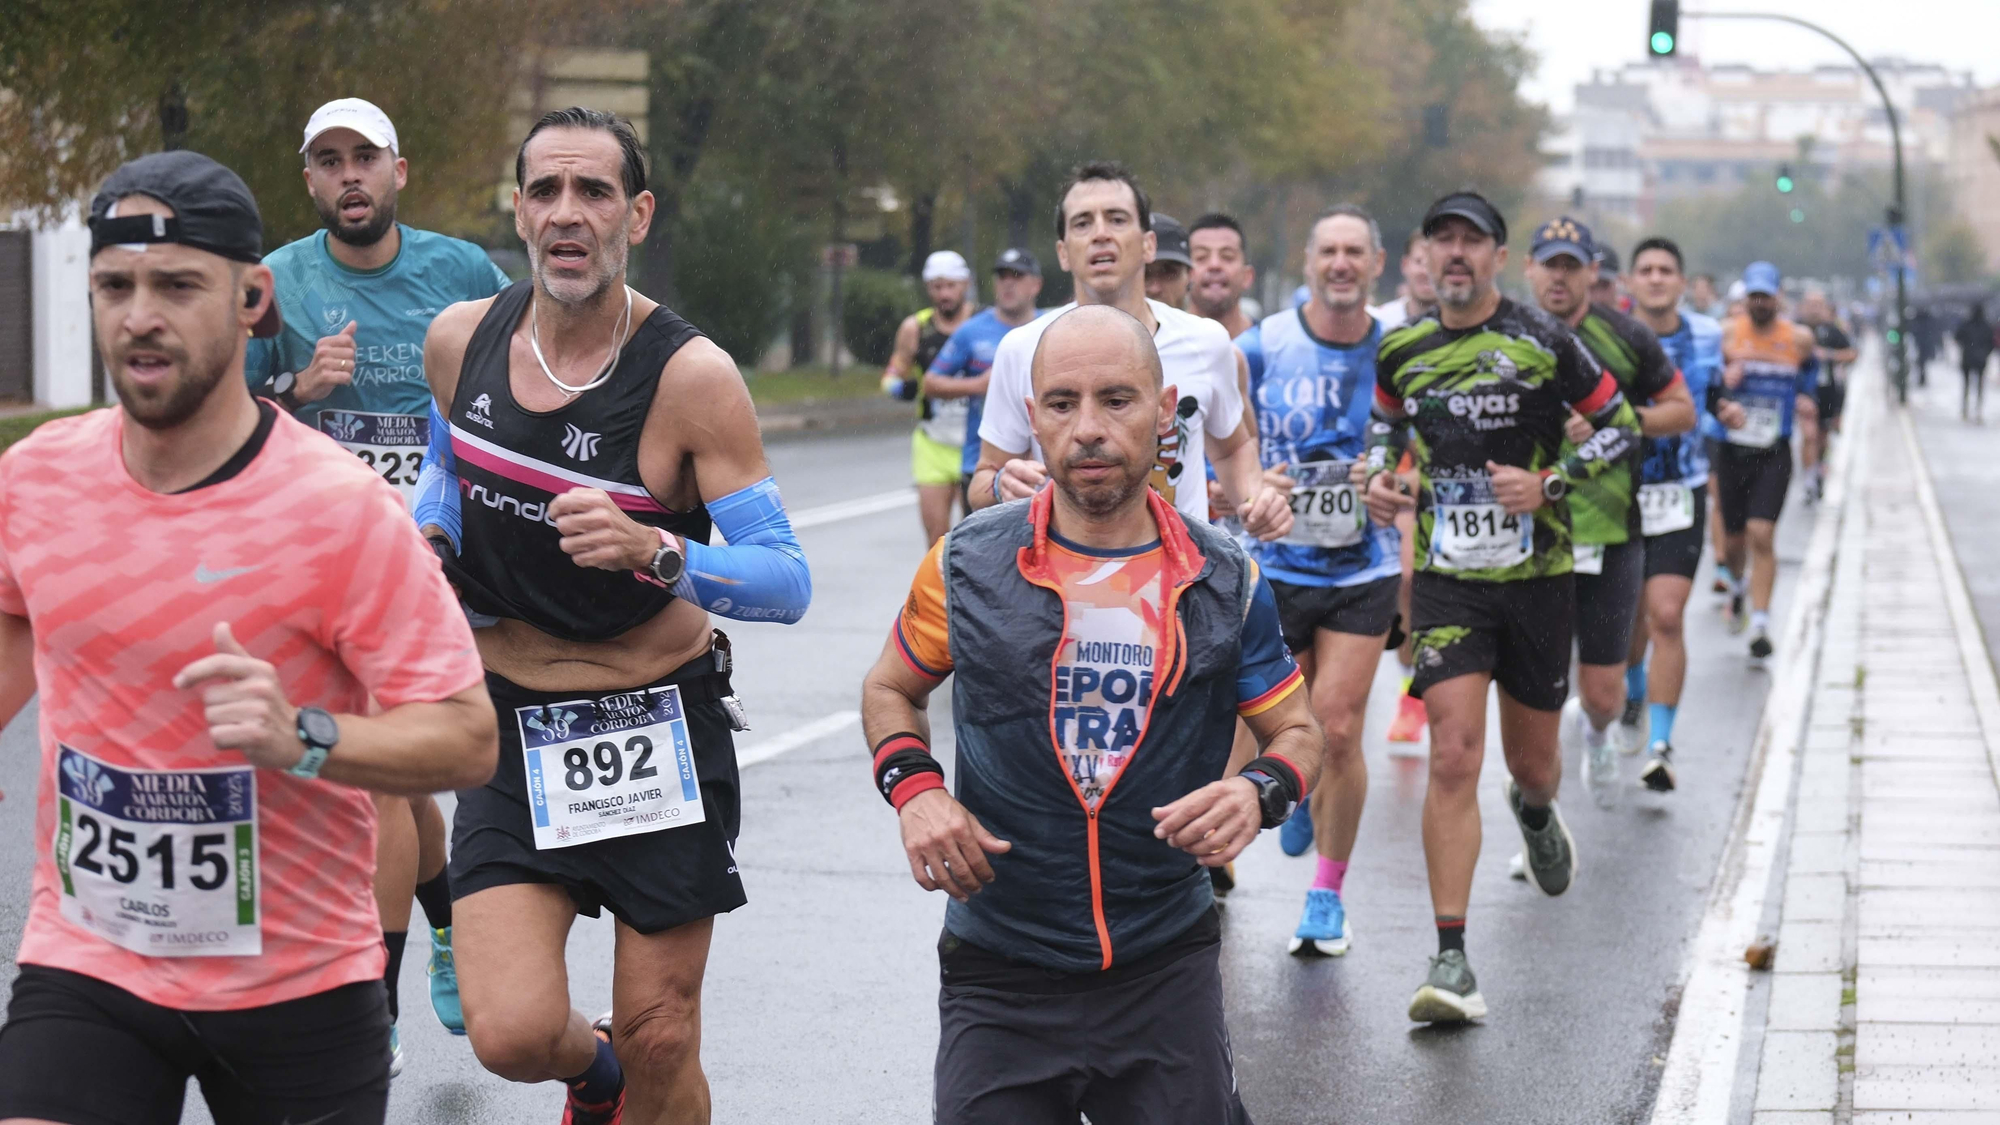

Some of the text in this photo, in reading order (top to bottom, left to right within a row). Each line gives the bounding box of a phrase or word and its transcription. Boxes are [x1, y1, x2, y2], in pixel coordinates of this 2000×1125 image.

[376, 416, 416, 428] MEDIA
[465, 411, 494, 429] austral
[1448, 508, 1519, 538] 1814
[733, 605, 786, 619] ZURICH
[1077, 641, 1152, 666] MONTORO
[563, 735, 658, 791] 892
[678, 748, 691, 780] CAJÓN
[131, 774, 207, 793] MEDIA
[532, 776, 545, 806] CAJÓN
[568, 788, 663, 815] FRANCISCO JAVIER
[636, 807, 681, 825] IMDECO
[74, 814, 229, 891] 2515
[238, 859, 252, 901] CAJÓN
[119, 896, 171, 917] CARLOS
[167, 930, 229, 945] IMDECO
